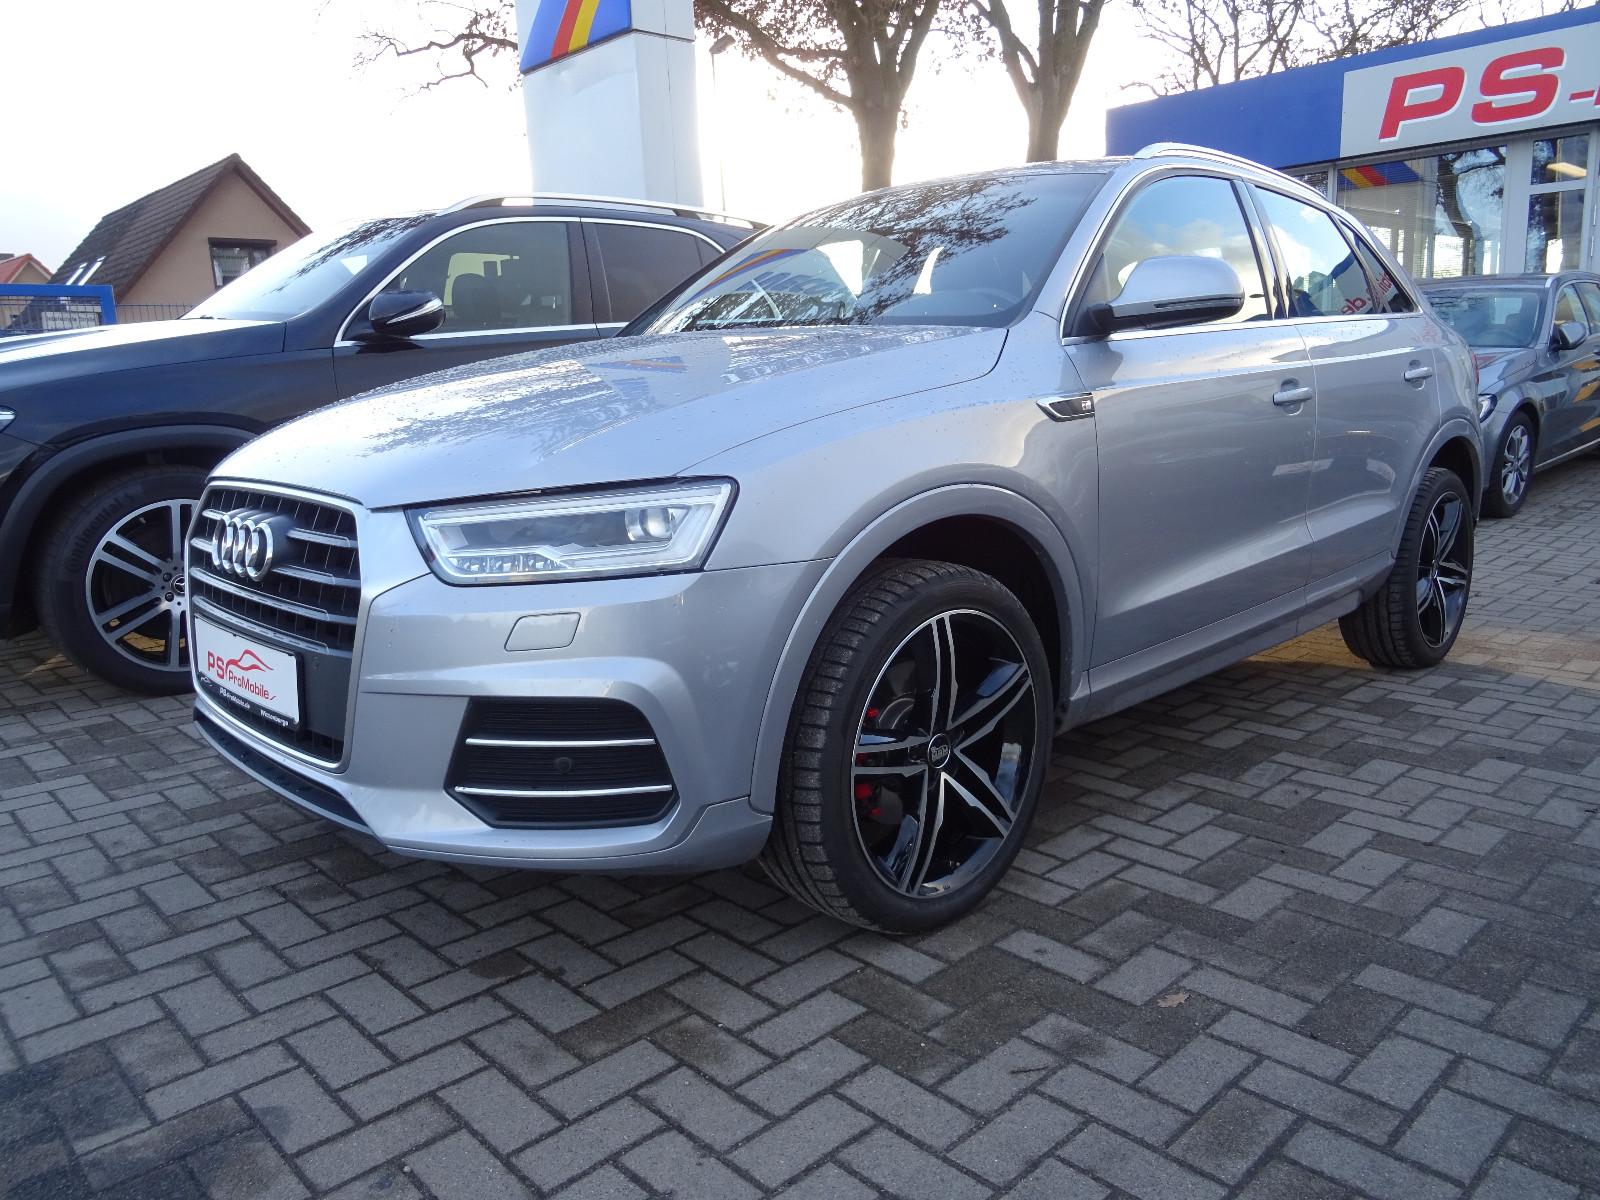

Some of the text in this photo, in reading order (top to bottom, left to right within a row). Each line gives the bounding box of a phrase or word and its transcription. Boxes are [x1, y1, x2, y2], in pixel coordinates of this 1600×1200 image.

[1378, 46, 1600, 141] PS-
[207, 650, 225, 680] PS
[228, 669, 270, 700] ProMobile
